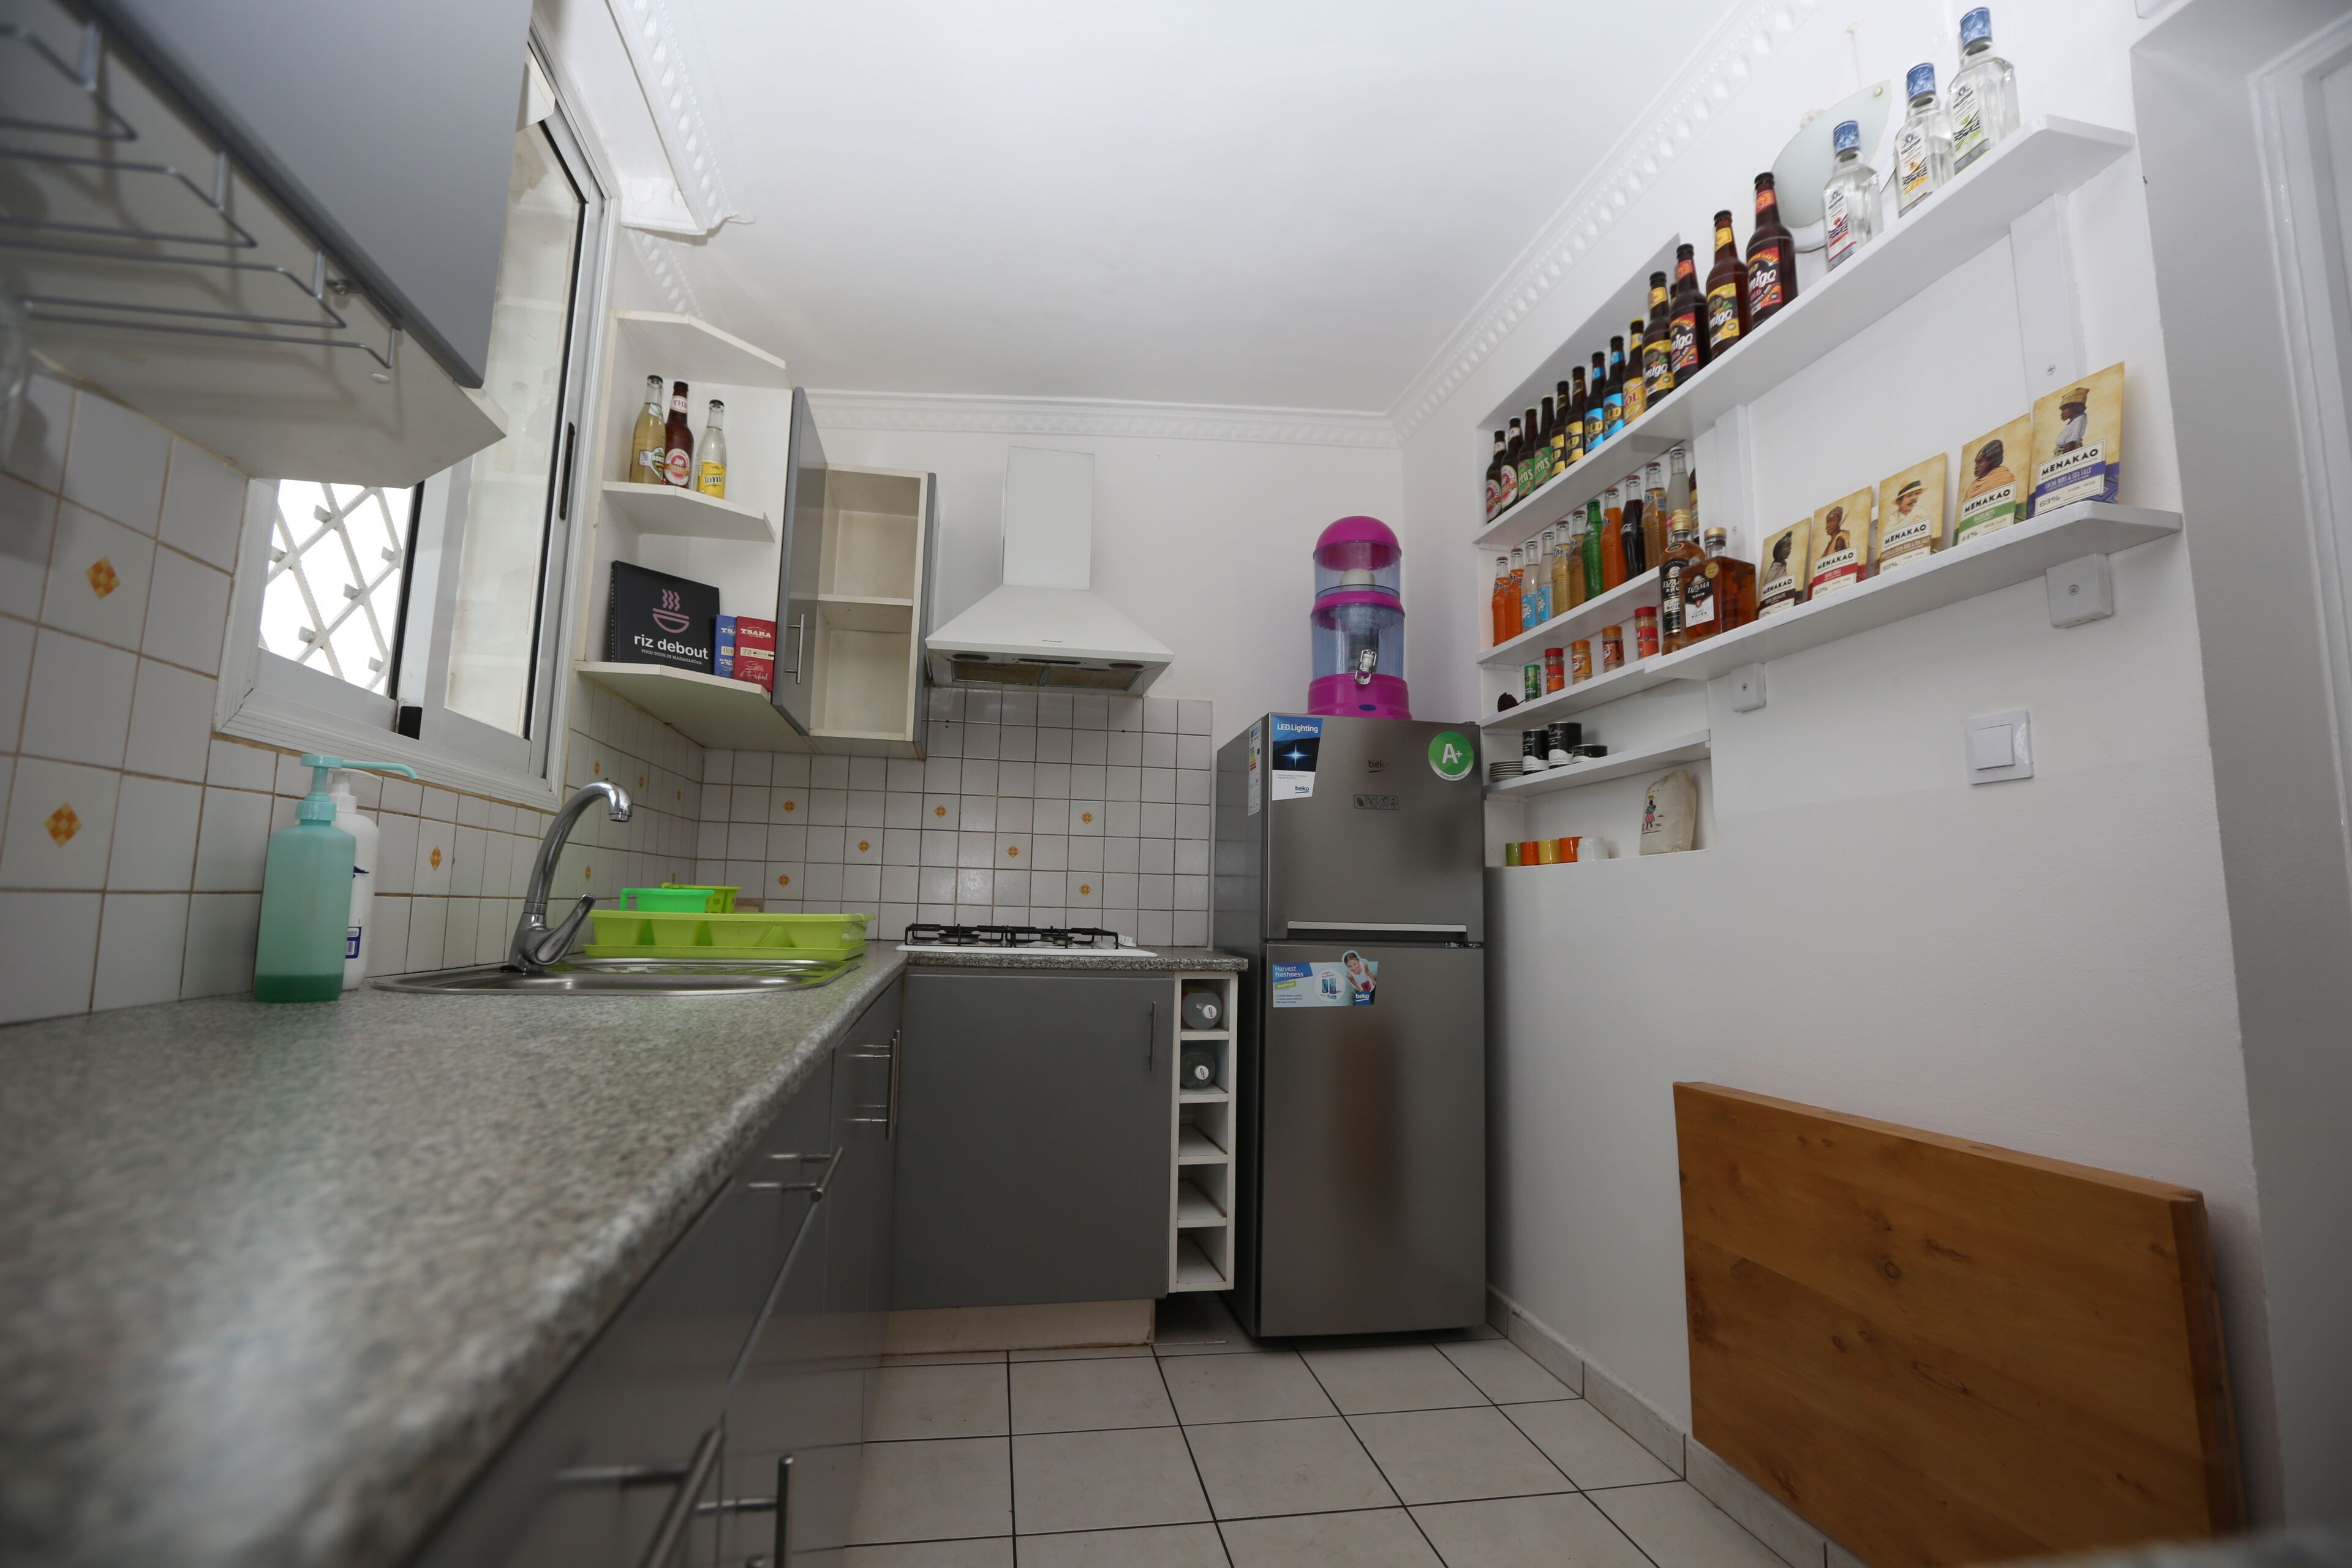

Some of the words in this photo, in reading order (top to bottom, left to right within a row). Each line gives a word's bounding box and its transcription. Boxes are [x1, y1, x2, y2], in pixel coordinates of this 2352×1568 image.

[1749, 269, 1777, 292] migo
[1709, 309, 1733, 330] migo
[1672, 333, 1694, 351] migo
[2041, 448, 2098, 476] MENAKAO
[1964, 489, 2011, 513] MENAKAO
[2039, 495, 2060, 508] 63%
[1884, 524, 1927, 545] MENAKAO
[1817, 552, 1854, 570] MENAKAO
[1687, 581, 1710, 594] DZAMA
[1763, 579, 1793, 595] MENAKAO
[741, 628, 772, 638] TSARA
[635, 635, 654, 648] riz
[657, 639, 709, 659] debout
[672, 655, 703, 665] MADAGASCAR
[1291, 724, 1319, 733] Lighting
[1442, 743, 1463, 764] A+
